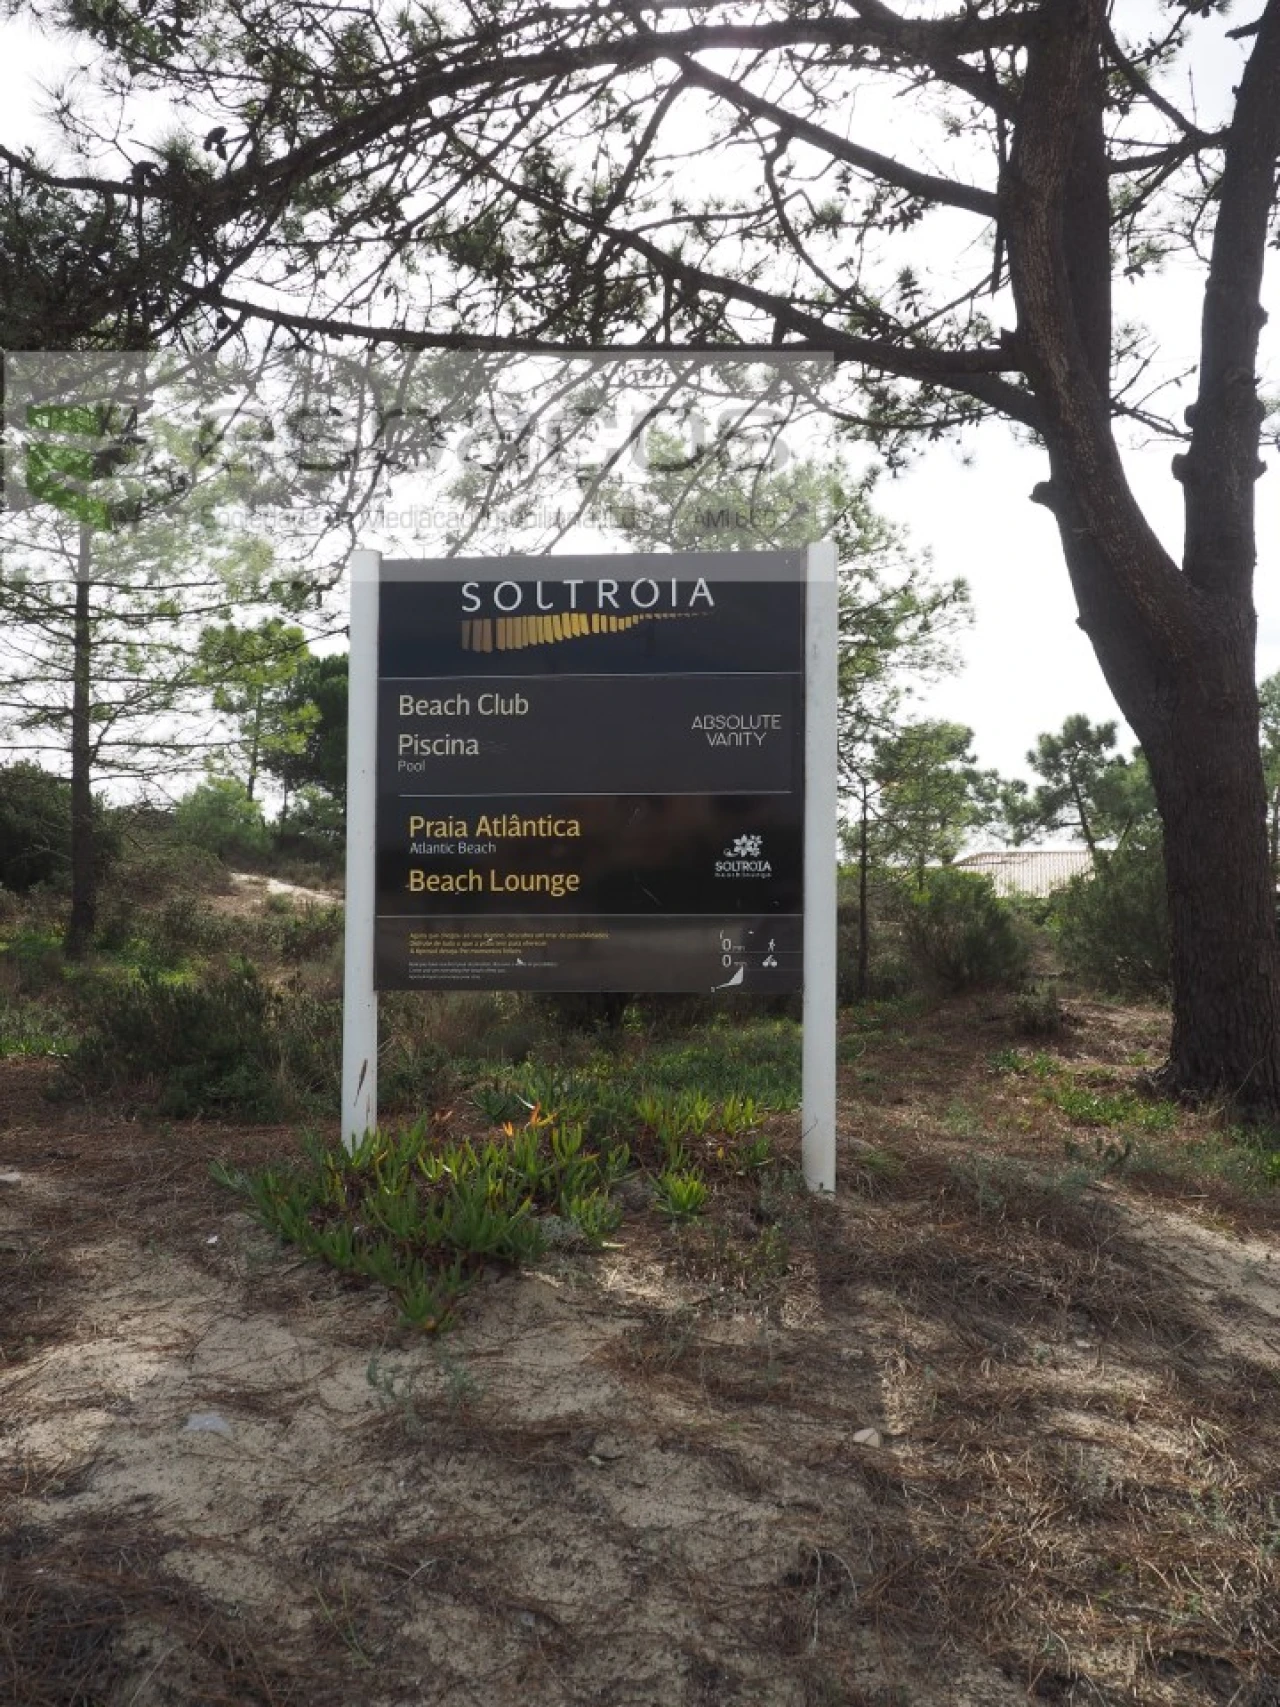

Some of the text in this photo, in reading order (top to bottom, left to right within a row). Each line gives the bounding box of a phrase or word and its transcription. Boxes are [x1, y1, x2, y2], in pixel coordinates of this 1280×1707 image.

[461, 577, 715, 612] SOLTROIA
[399, 693, 529, 716] Beach Club
[691, 714, 782, 730] ABSOLUTE
[398, 734, 479, 756] Piscina
[706, 731, 767, 747] VANITY
[398, 760, 426, 773] Pool
[409, 813, 581, 838] Praia Atlântica
[409, 842, 497, 855] Atlantic Beach
[715, 860, 772, 872] SOLTROIA
[409, 870, 580, 897] Beach Lounge
